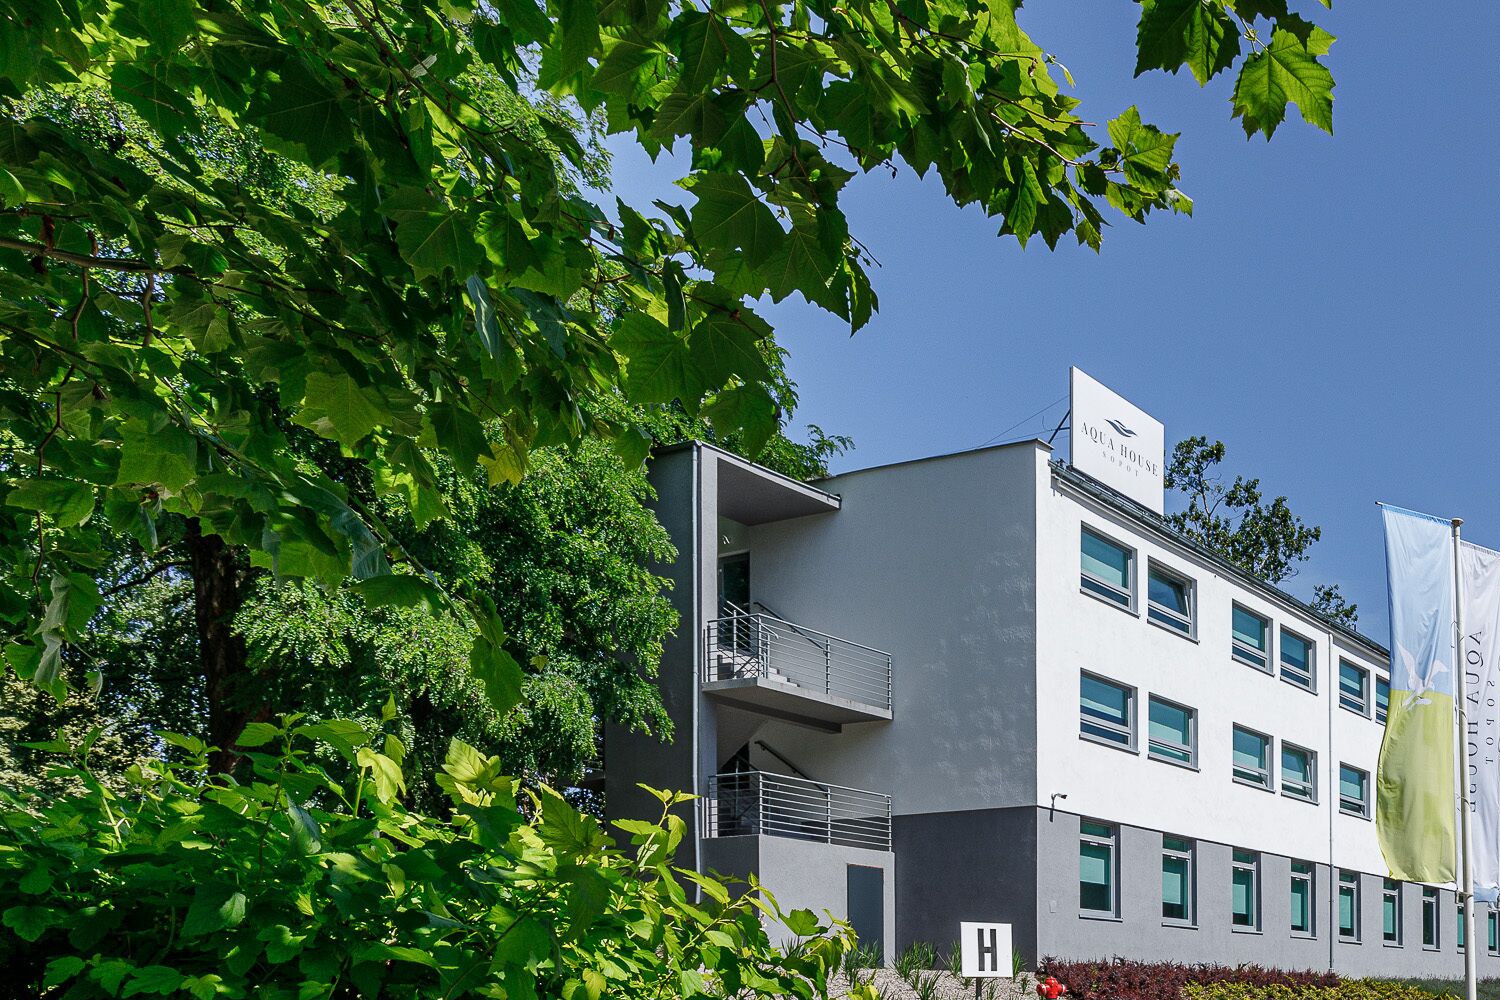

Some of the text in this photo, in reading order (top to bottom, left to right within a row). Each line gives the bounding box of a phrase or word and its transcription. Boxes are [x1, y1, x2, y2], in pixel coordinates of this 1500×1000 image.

[1081, 421, 1158, 477] AQUA HOUSE
[1102, 451, 1139, 477] SOPOT
[977, 928, 998, 972] H
